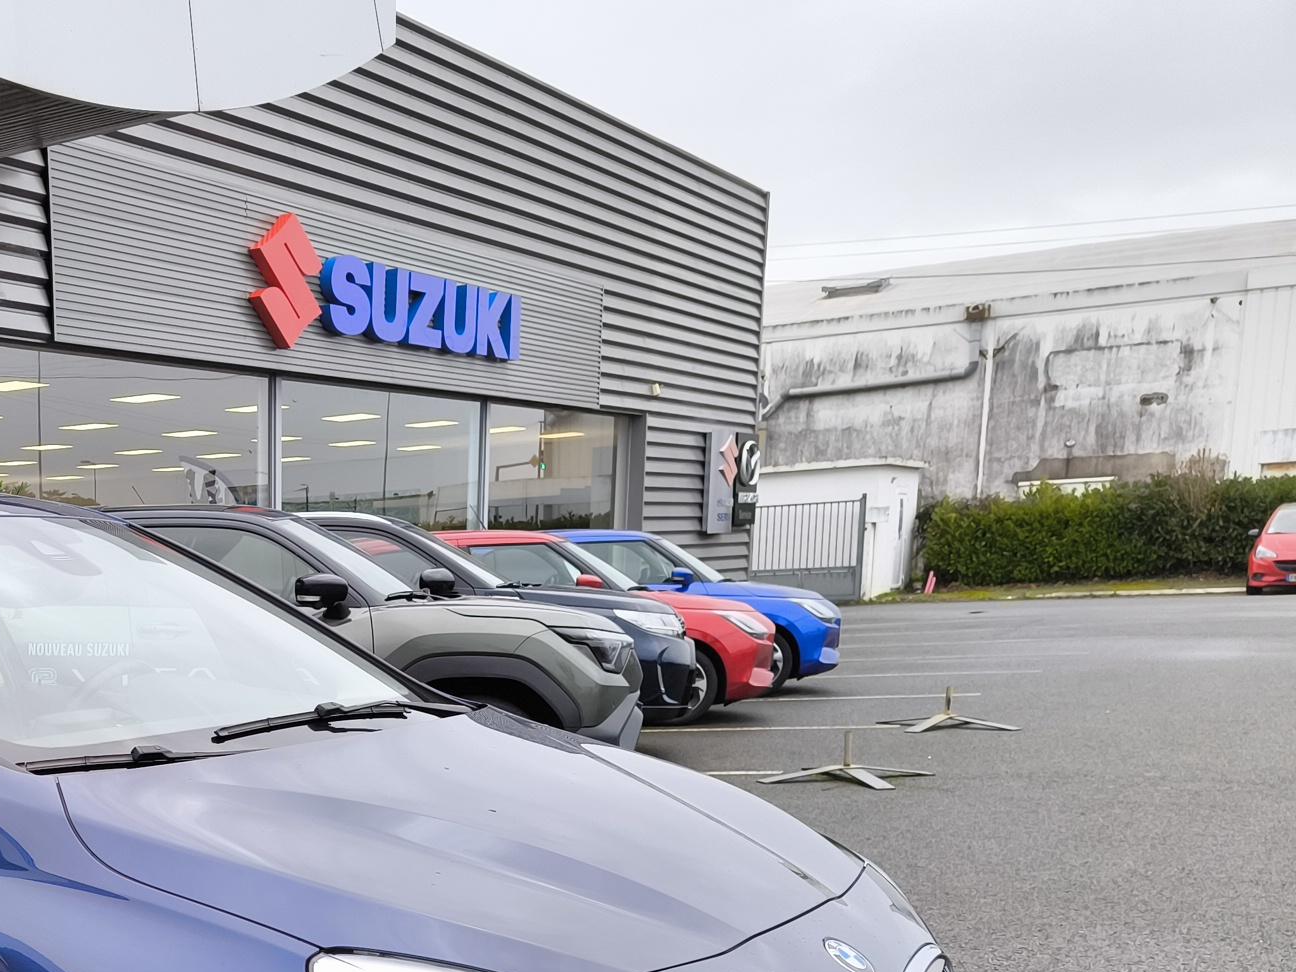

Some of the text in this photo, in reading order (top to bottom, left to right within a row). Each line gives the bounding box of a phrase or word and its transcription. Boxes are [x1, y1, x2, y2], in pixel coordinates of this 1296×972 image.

[320, 255, 522, 362] SUZUKI
[28, 642, 130, 657] NOUVEAU SUZUKI
